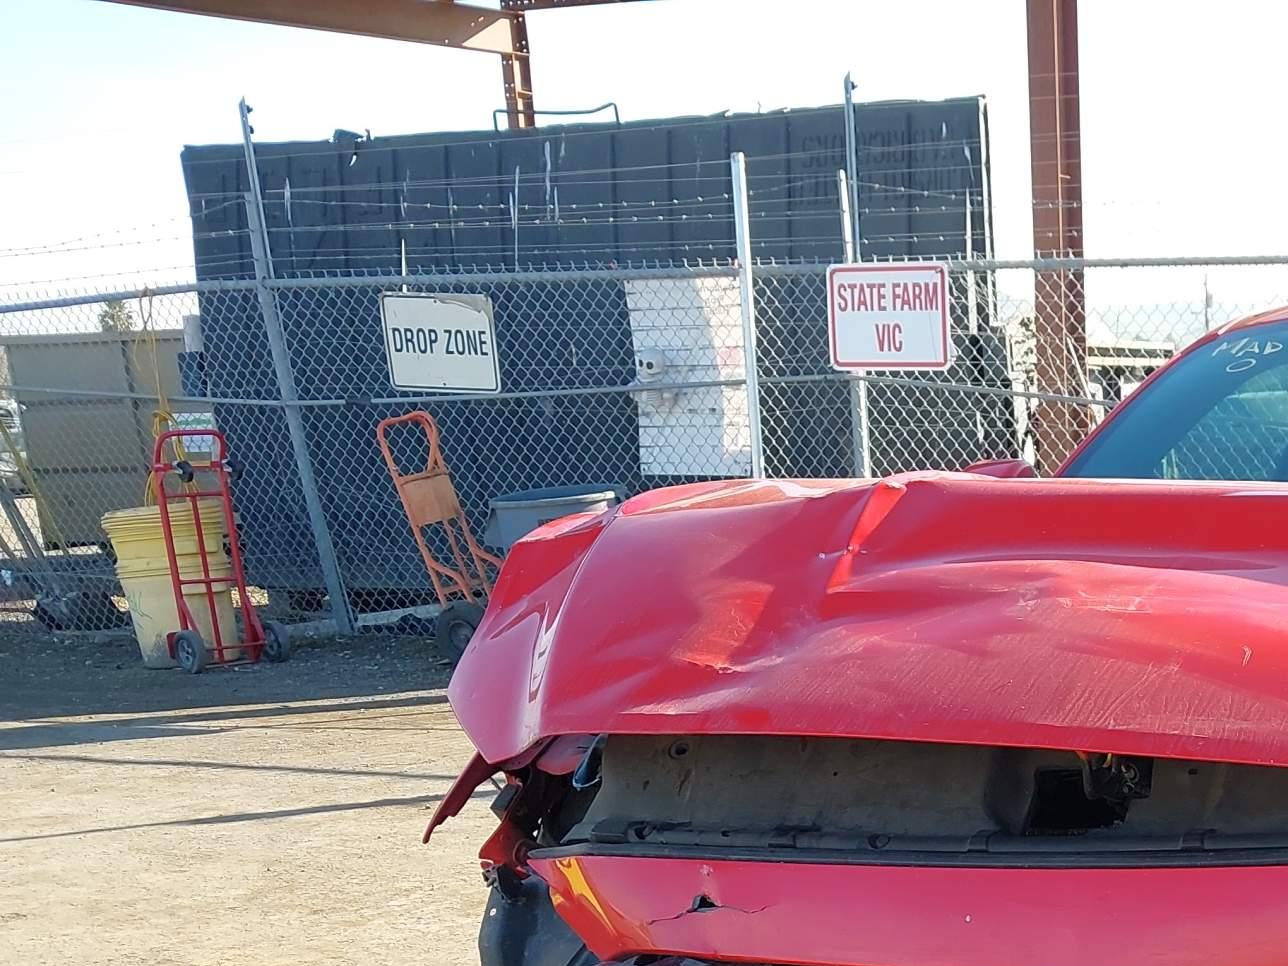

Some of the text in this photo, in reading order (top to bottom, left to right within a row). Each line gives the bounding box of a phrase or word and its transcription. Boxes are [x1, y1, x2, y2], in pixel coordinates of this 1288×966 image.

[837, 282, 939, 312] STATE FARM
[390, 327, 489, 356] DROP ZONE
[875, 323, 903, 352] VIC
